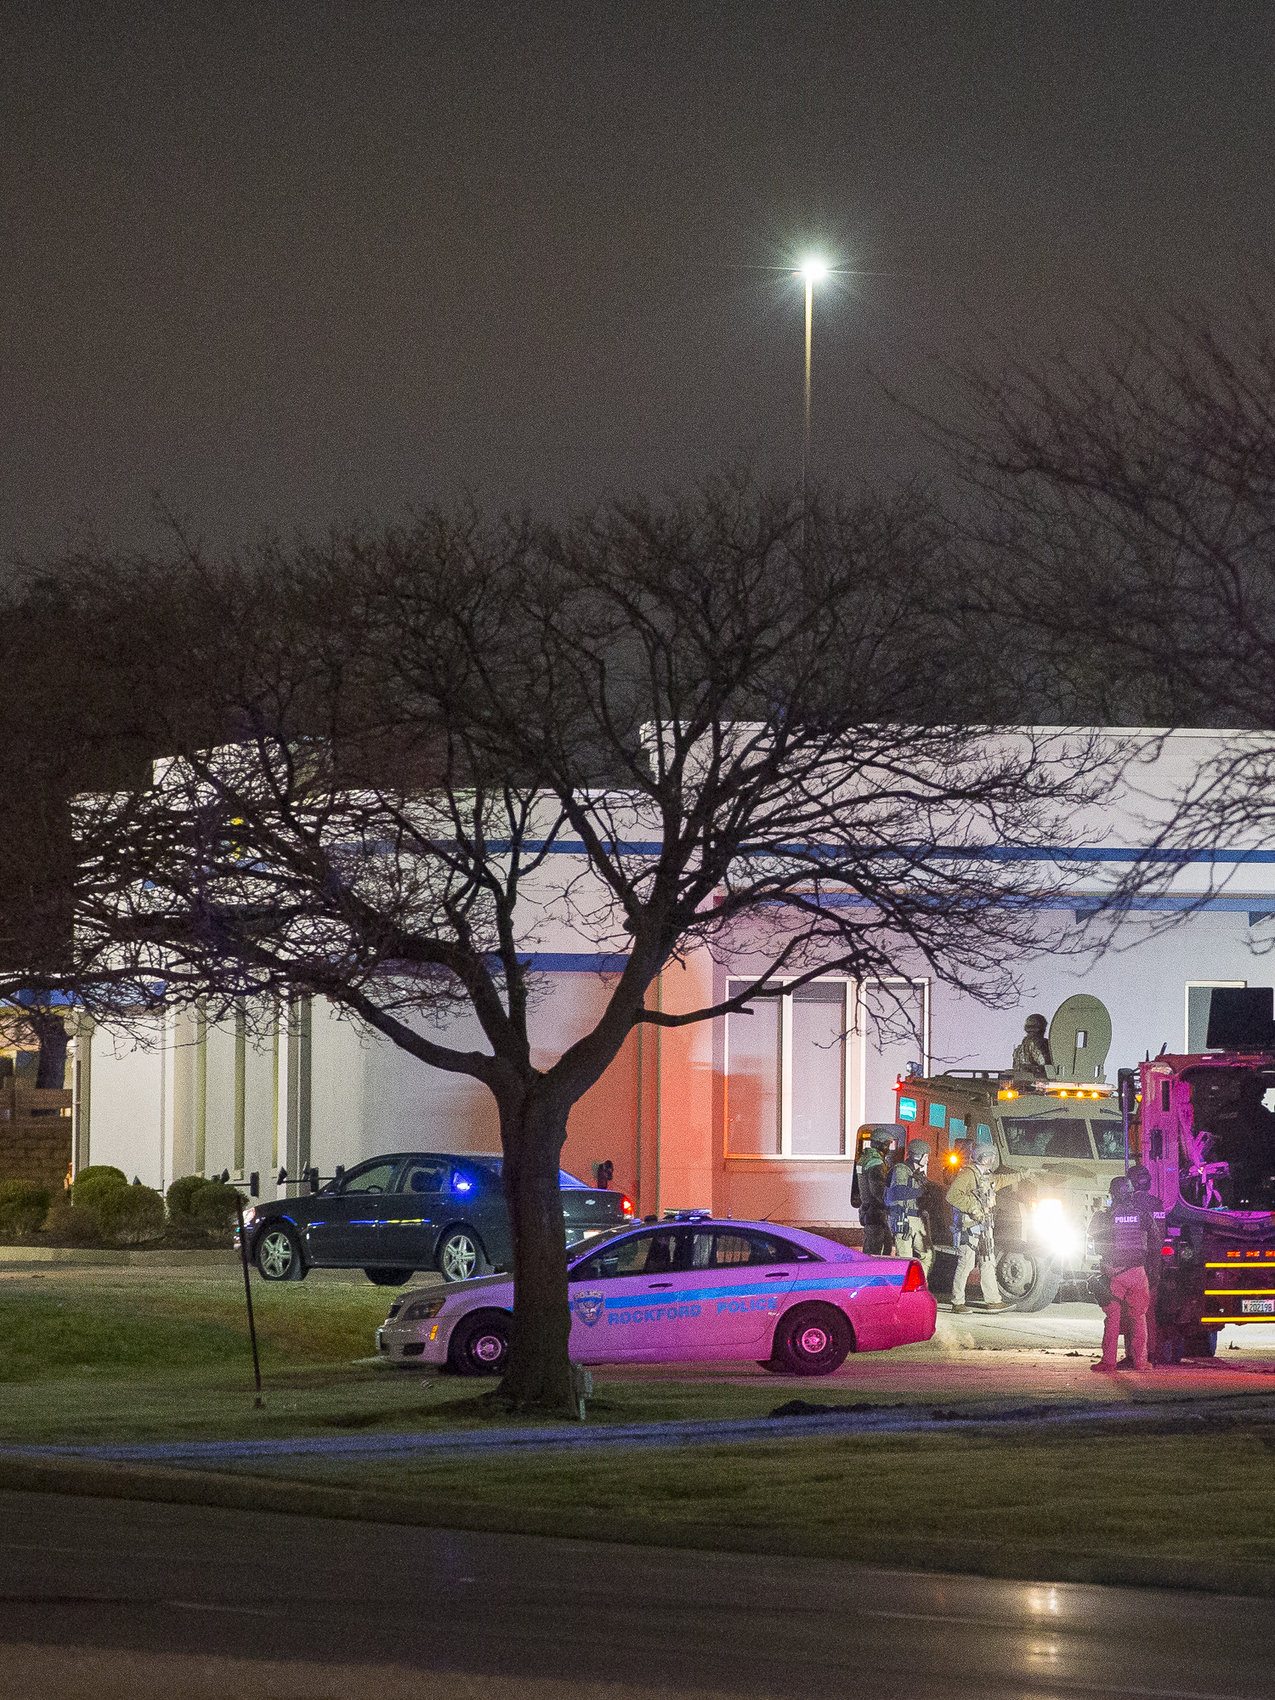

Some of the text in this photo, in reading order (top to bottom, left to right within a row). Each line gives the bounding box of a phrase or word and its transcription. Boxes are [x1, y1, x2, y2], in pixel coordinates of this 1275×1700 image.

[1114, 1215, 1138, 1223] POLICE
[607, 1297, 778, 1325] ROCKFORD POLICE
